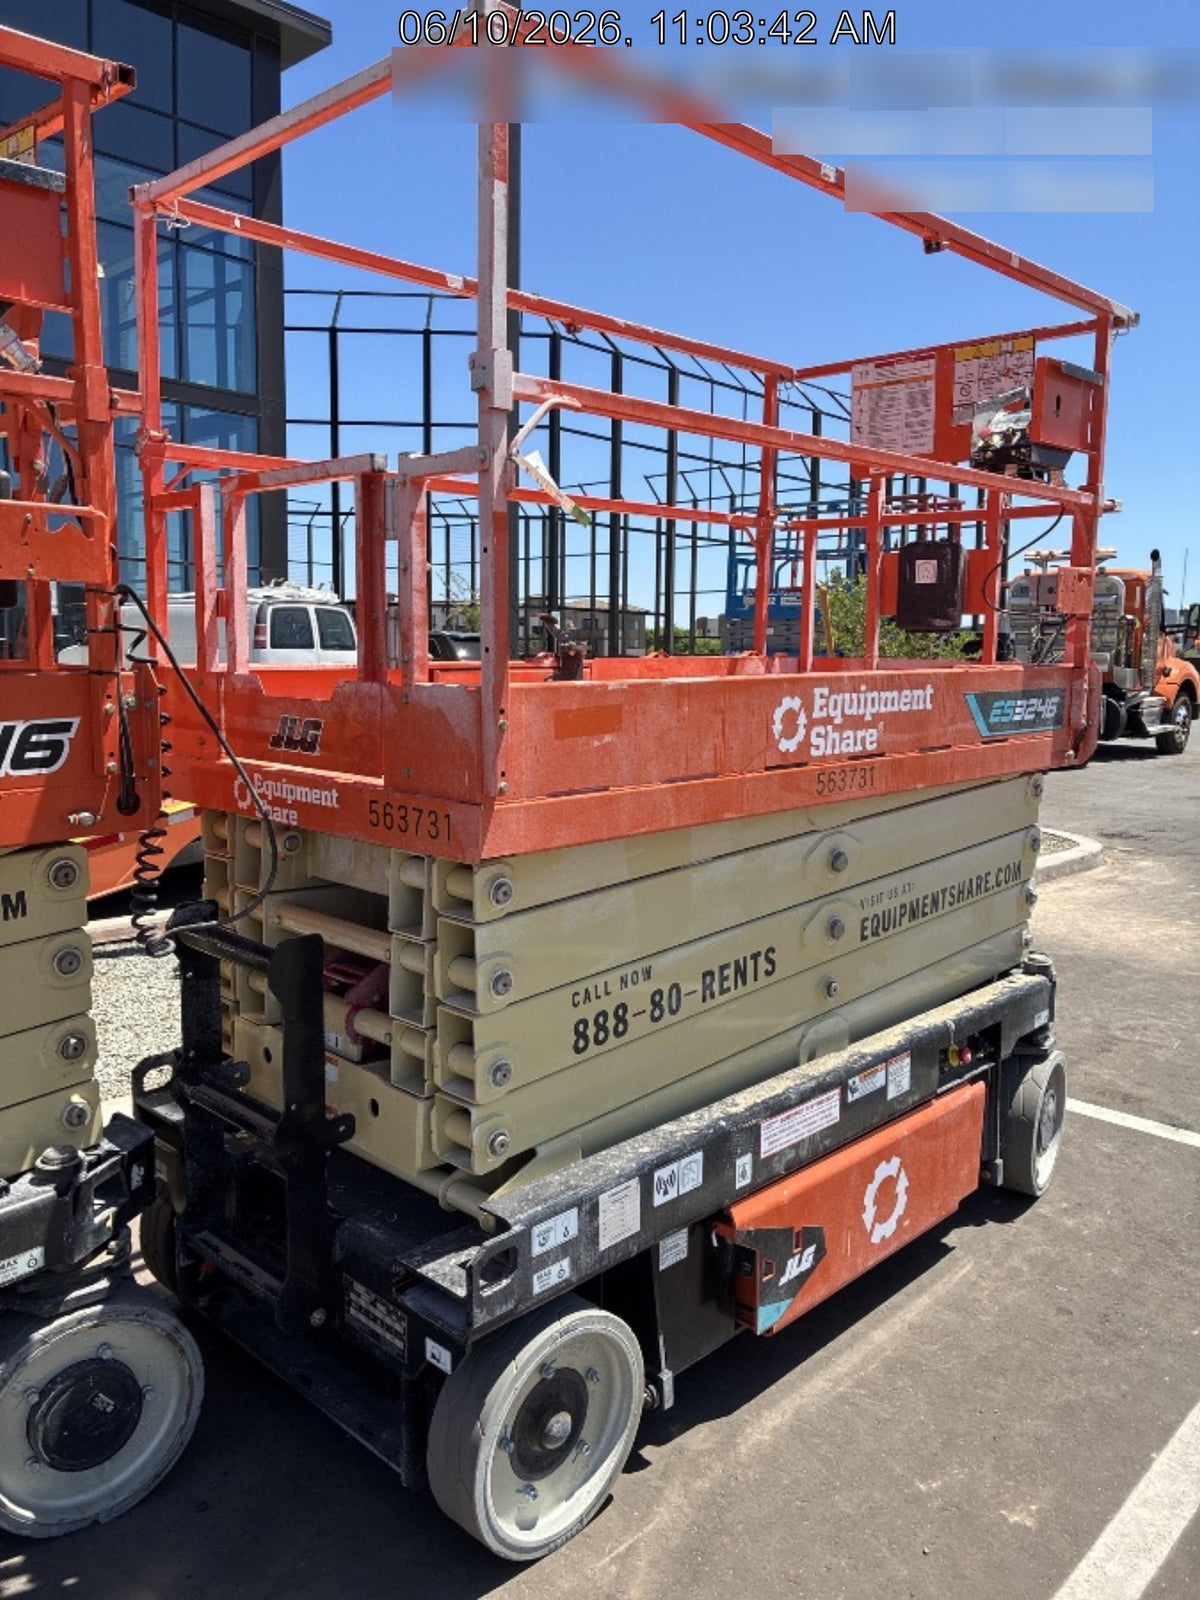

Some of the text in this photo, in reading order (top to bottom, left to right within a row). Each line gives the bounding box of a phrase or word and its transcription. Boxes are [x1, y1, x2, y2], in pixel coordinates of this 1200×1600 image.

[812, 684, 934, 722] Equipment
[269, 714, 324, 756] JLG
[810, 724, 878, 756] Share
[254, 773, 339, 808] Equipment
[816, 765, 876, 795] 563731
[368, 800, 453, 841] 563731
[860, 860, 1022, 942] EQUIPMENTSHARE.COM
[571, 965, 652, 1008] CALL NOW
[572, 946, 776, 1055] 888-80-RENTS
[779, 1244, 816, 1286] JLG
